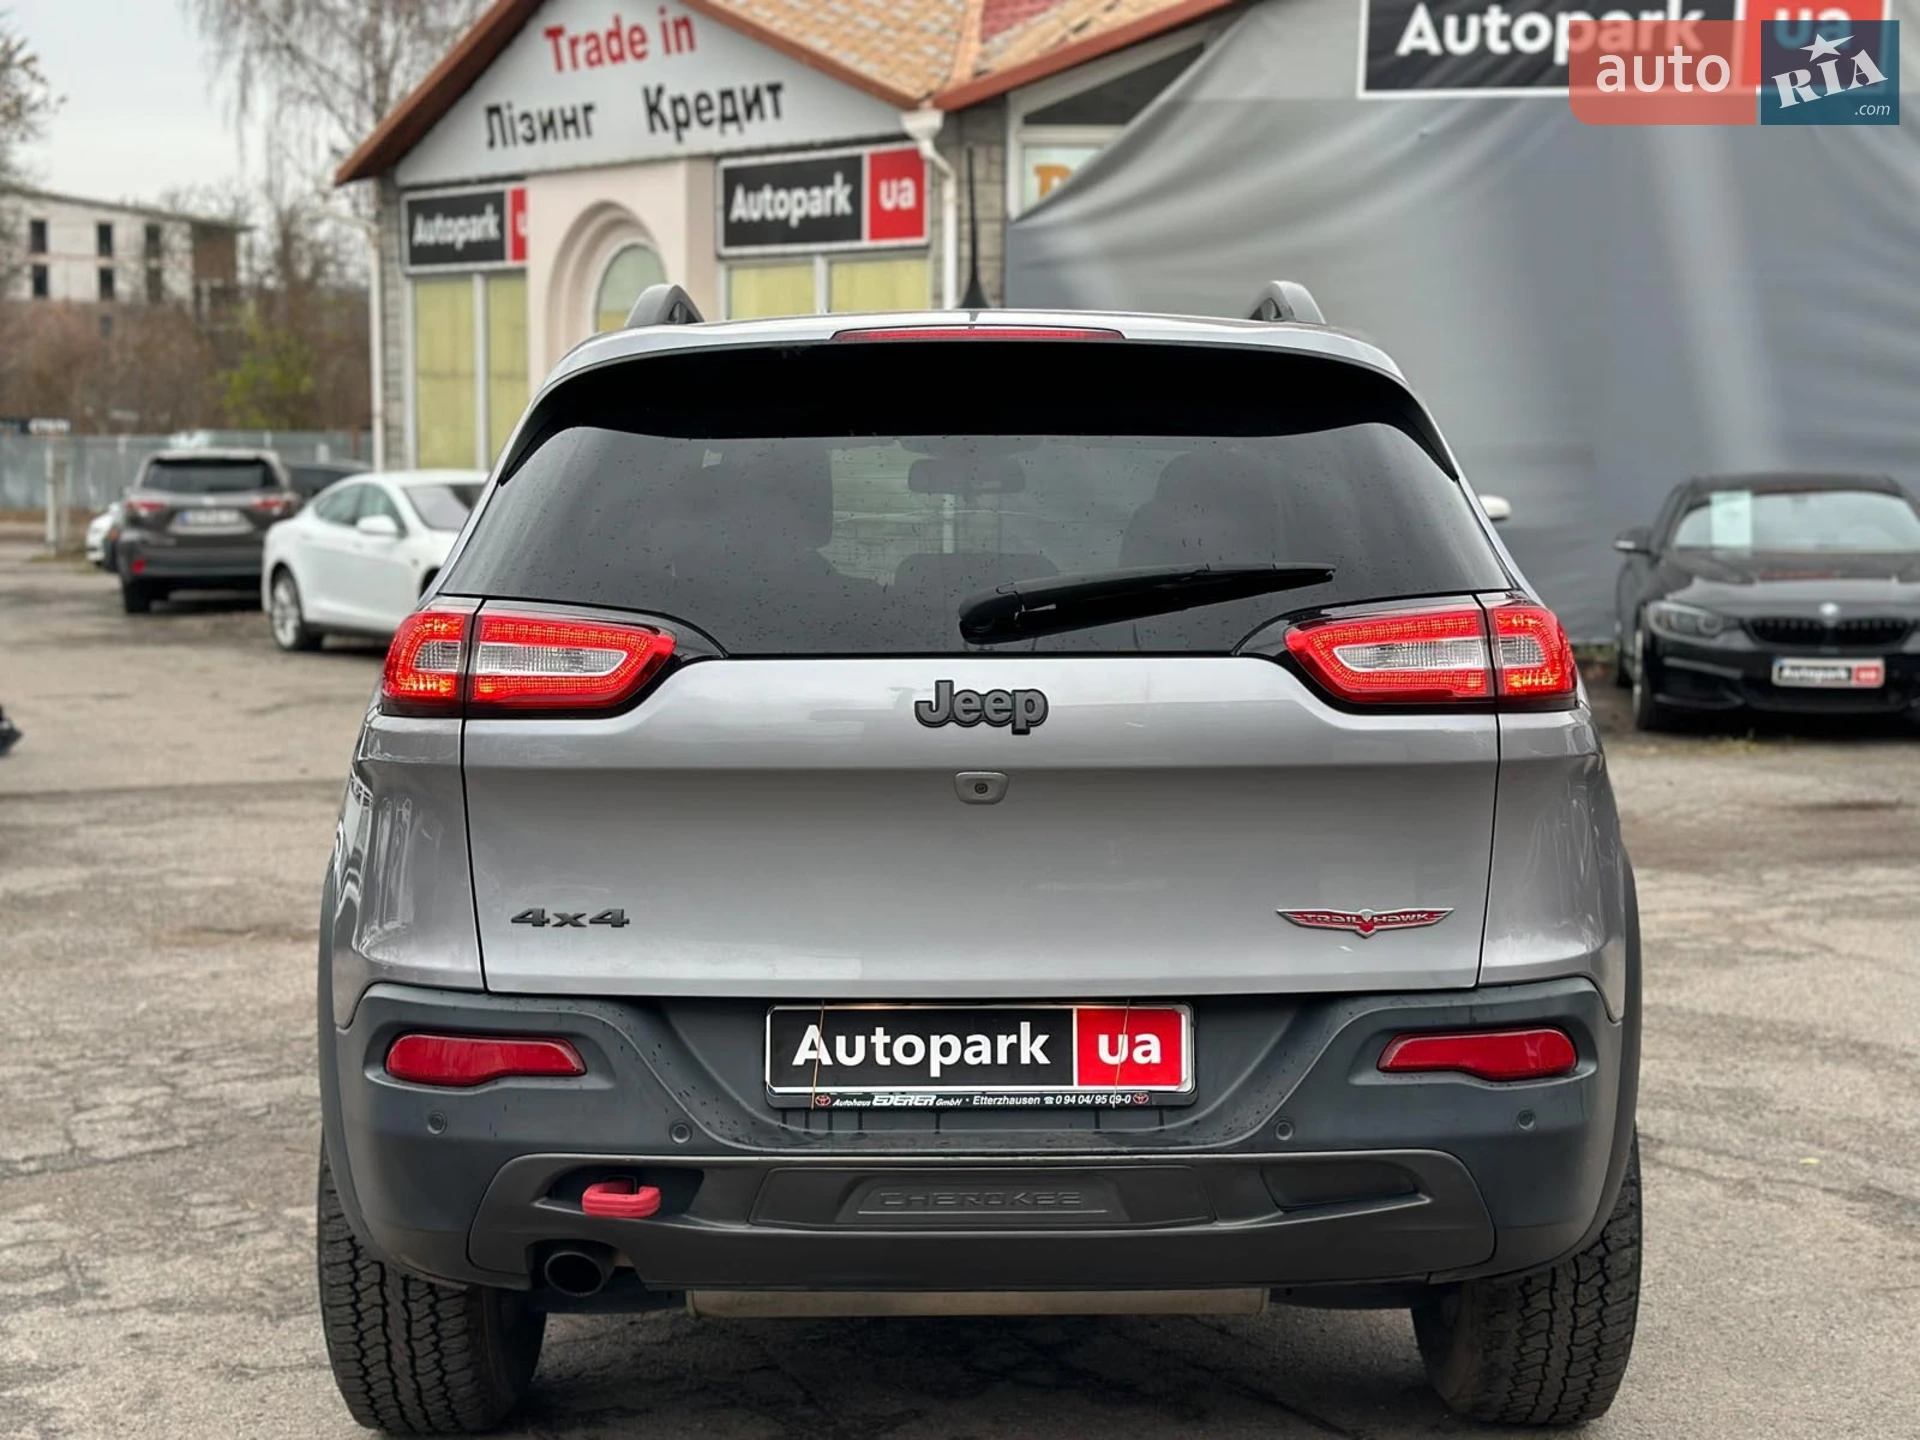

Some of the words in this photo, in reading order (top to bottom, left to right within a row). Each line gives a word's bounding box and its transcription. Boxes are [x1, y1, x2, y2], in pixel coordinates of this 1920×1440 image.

[544, 15, 649, 73] Trade
[658, 5, 697, 56] in
[1395, 0, 1706, 65] Autopark
[1774, 5, 1852, 49] ua
[485, 101, 596, 150] Лізинг
[643, 82, 784, 143] Кредит
[411, 202, 501, 252] Autopark
[730, 171, 853, 228] Autopark
[880, 176, 917, 212] ua
[914, 679, 1049, 736] Jeep
[511, 907, 630, 928] 4x4
[792, 1021, 1051, 1078] Autopark
[1098, 1032, 1162, 1067] ua
[832, 1098, 871, 1107] Autohaus
[872, 1095, 937, 1107] EDERER
[936, 1098, 963, 1107] GmbH
[972, 1095, 1041, 1106] Etterzhausen
[880, 1191, 1081, 1206] CHEROKEE
